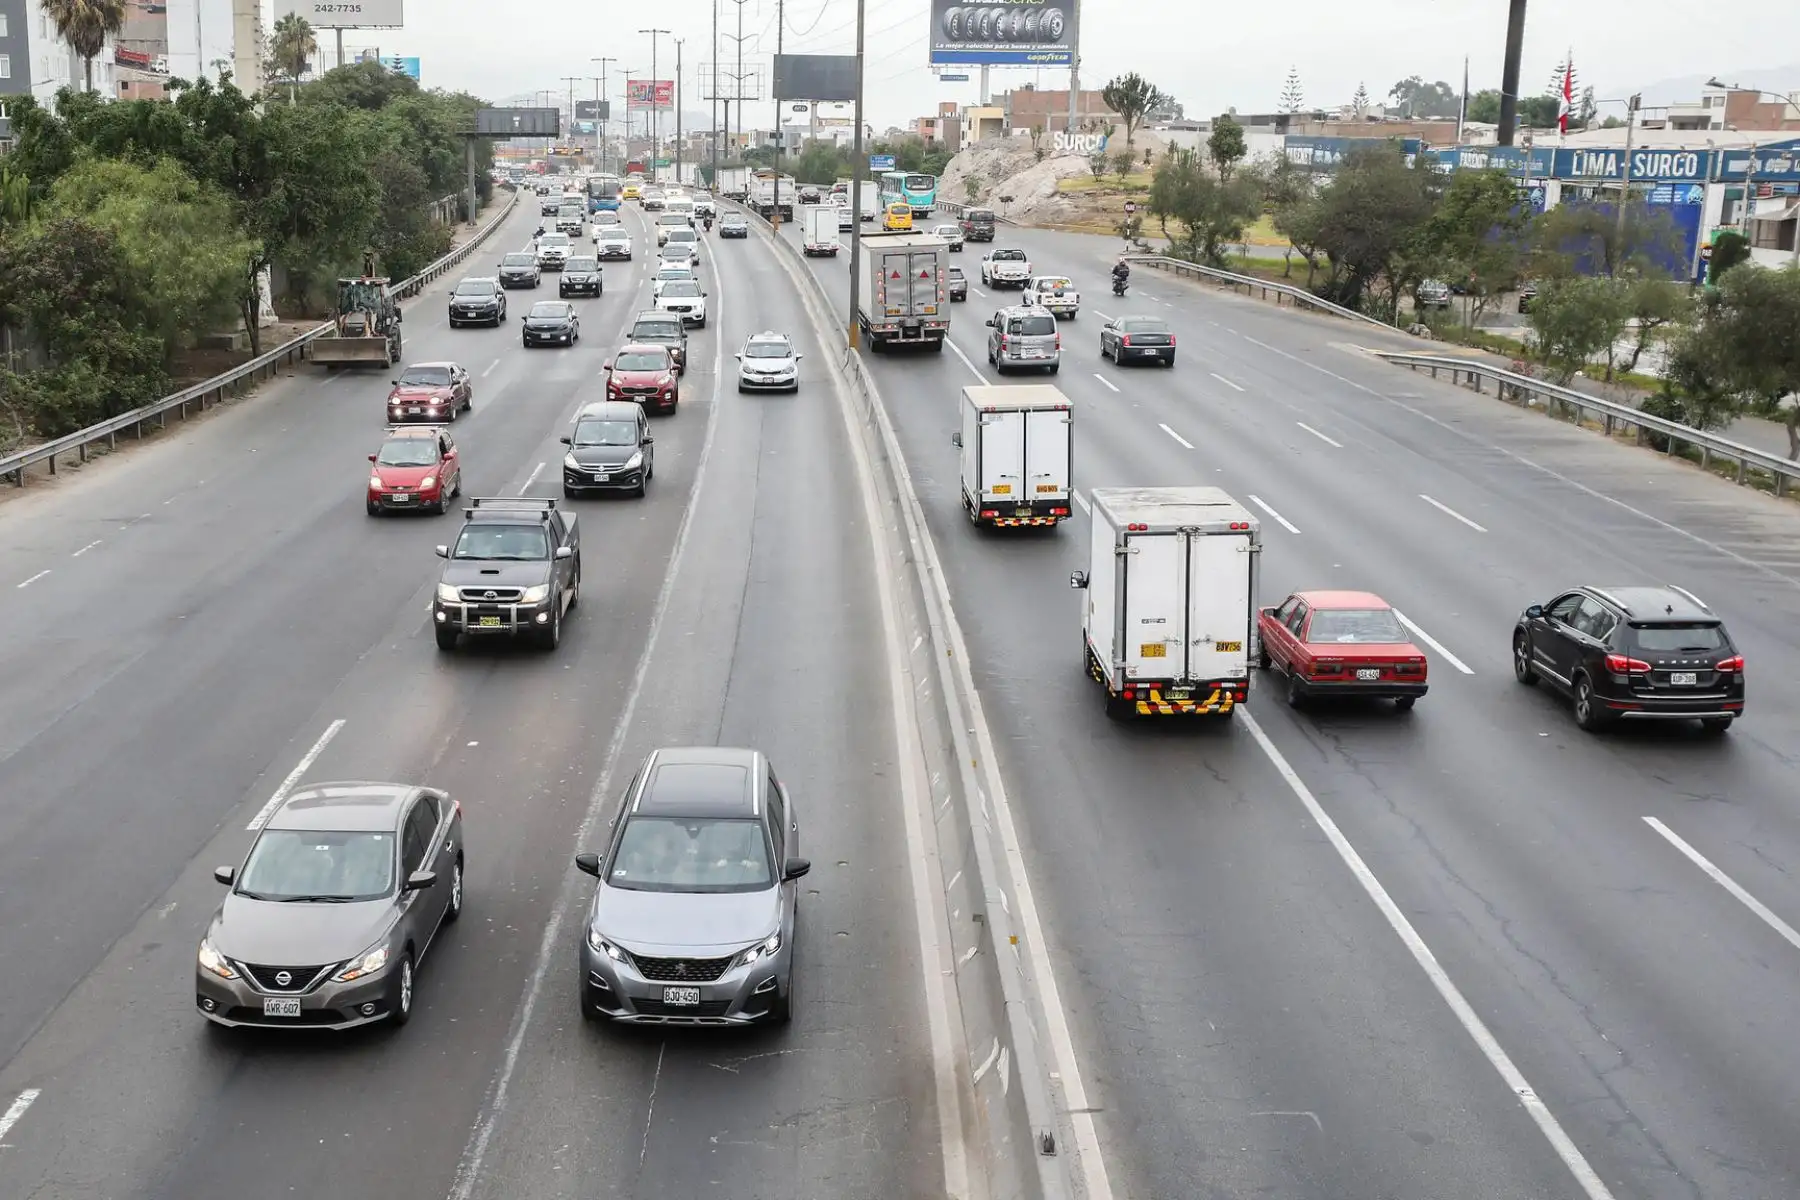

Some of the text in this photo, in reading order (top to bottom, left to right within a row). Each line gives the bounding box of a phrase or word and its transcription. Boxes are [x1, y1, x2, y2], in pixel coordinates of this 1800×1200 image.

[315, 4, 361, 13] 242-7735
[1571, 152, 1617, 176] LIMA
[1633, 152, 1697, 177] SURCO
[265, 1003, 298, 1014] AWR-607
